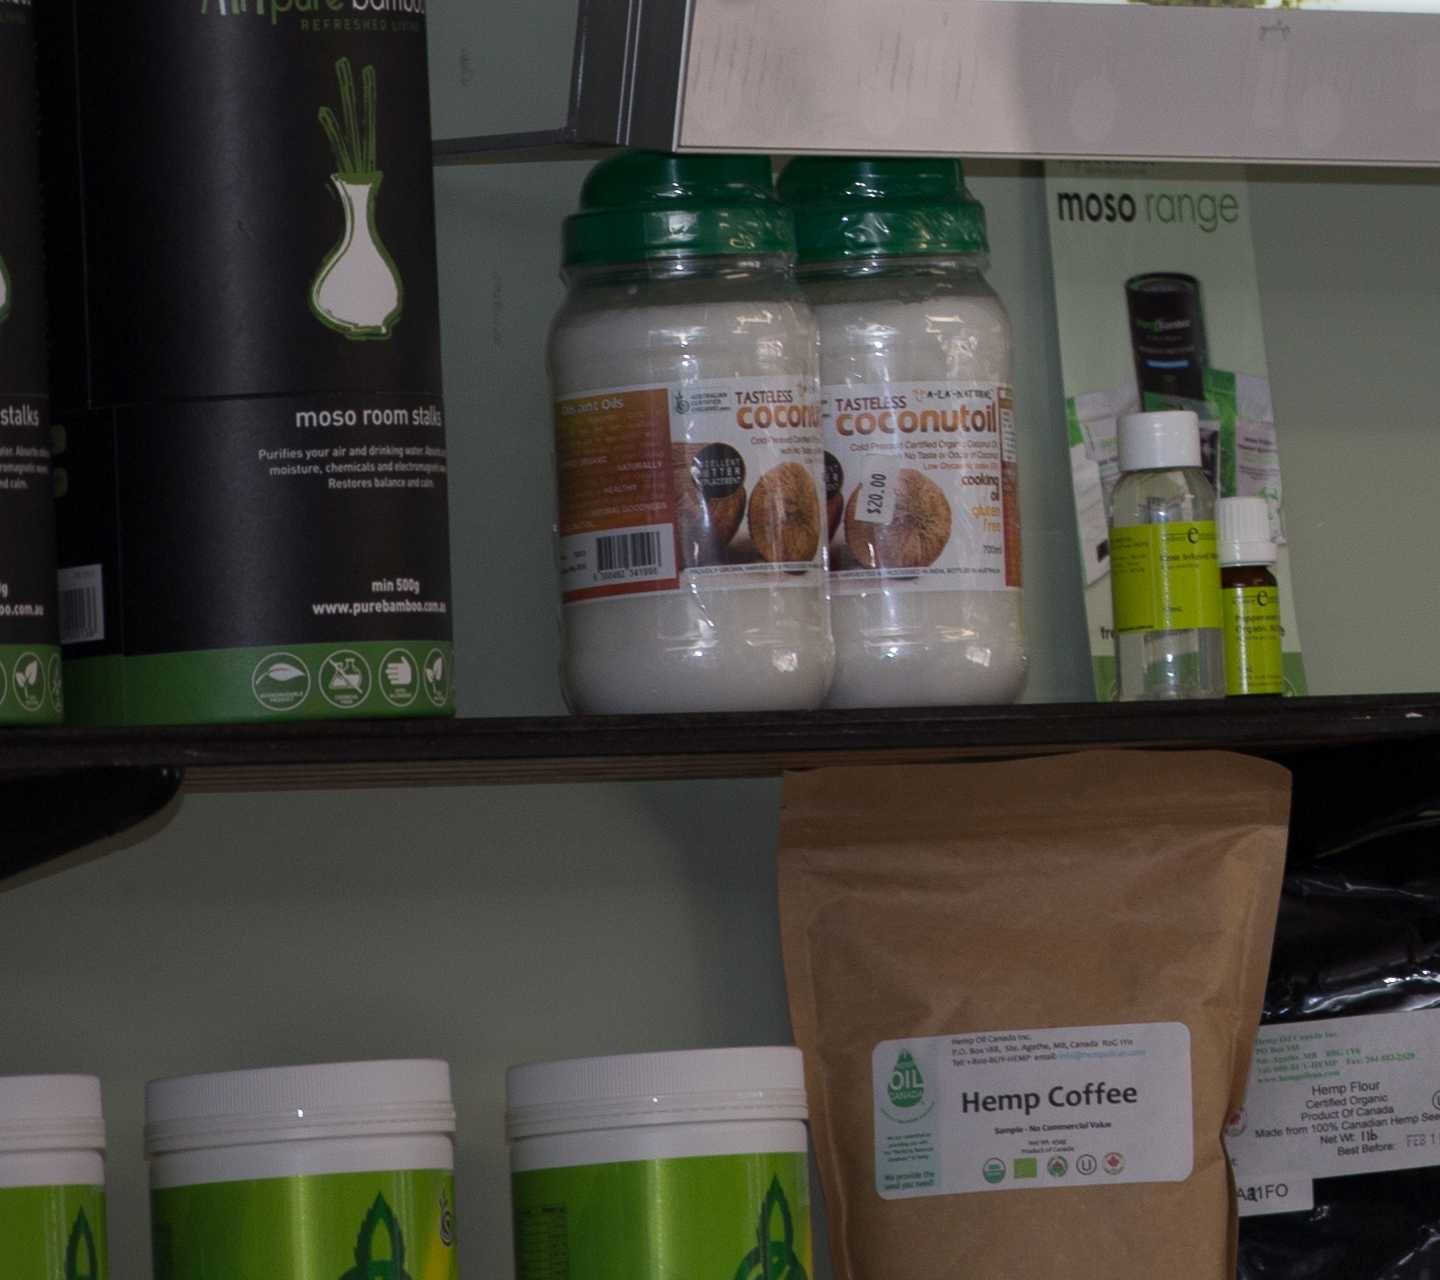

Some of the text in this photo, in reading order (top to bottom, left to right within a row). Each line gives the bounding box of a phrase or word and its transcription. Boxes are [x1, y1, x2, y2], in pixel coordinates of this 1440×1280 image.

[1057, 192, 1239, 233] moso range
[836, 396, 906, 411] TASTELESS
[296, 410, 356, 427] moso
[363, 408, 408, 425] room
[867, 473, 887, 515] $20.00
[372, 579, 394, 592] min
[1312, 1081, 1380, 1097] Hemp Flour
[962, 1082, 1138, 1116] Hemp Coffee
[1305, 1093, 1388, 1110] Certified Organic
[1301, 1105, 1394, 1122] Product Of Canada
[1255, 1127, 1283, 1139] Made
[1286, 1125, 1308, 1137] from
[1341, 1118, 1389, 1131] Canadian
[1390, 1114, 1419, 1128] Hemp
[1337, 1145, 1360, 1157] Best
